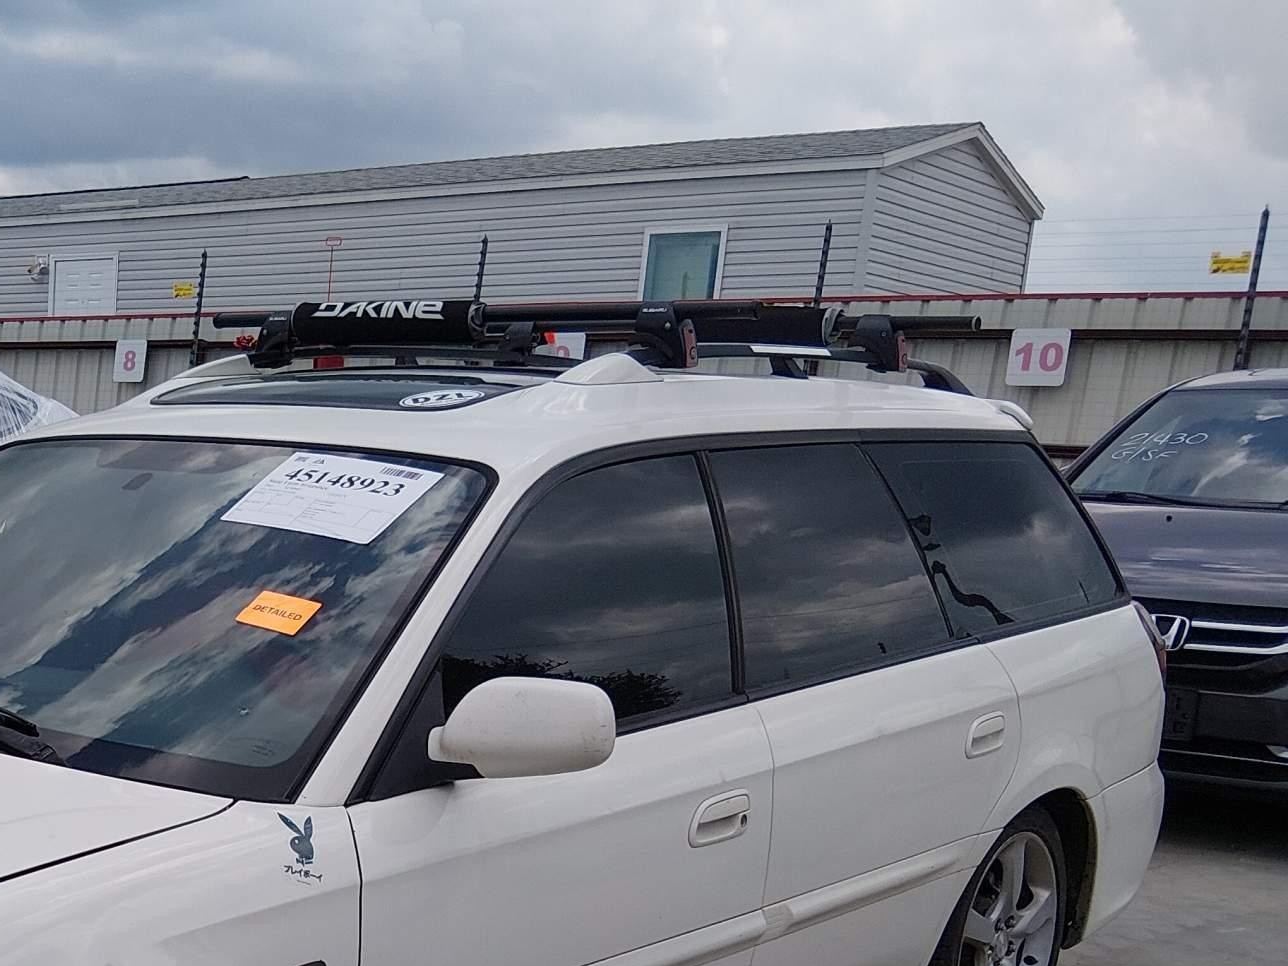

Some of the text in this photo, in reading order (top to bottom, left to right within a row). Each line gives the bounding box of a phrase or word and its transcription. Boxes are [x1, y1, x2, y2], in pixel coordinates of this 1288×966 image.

[310, 301, 445, 320] DAKINE
[123, 350, 137, 371] 8
[1014, 341, 1064, 372] 10
[284, 468, 405, 496] 45148923
[252, 604, 303, 621] DETAILED
